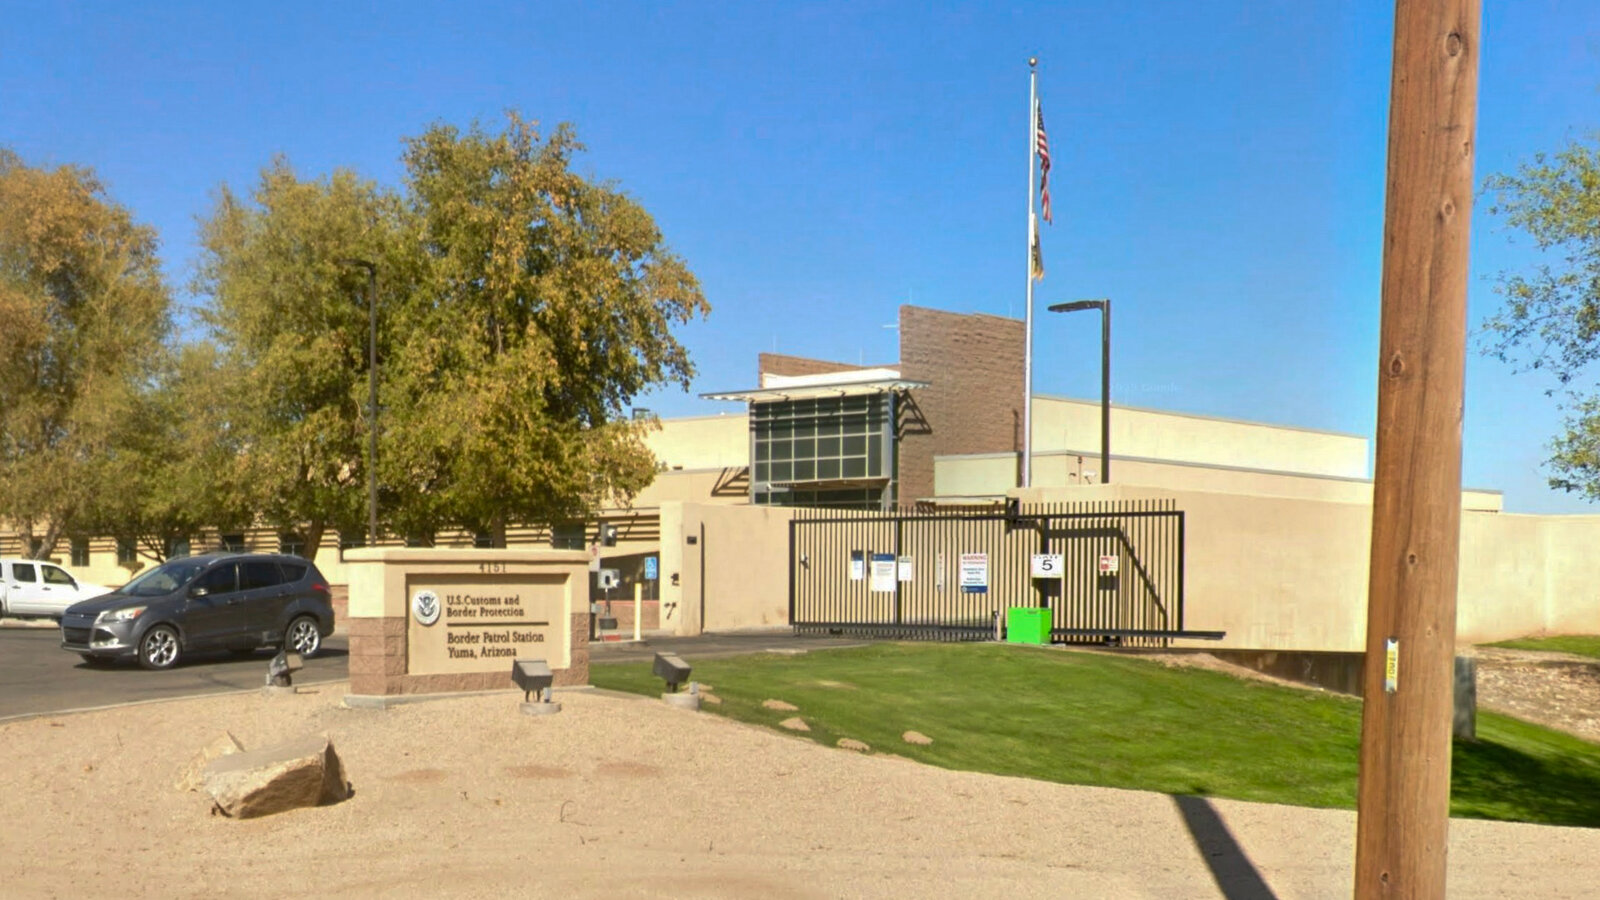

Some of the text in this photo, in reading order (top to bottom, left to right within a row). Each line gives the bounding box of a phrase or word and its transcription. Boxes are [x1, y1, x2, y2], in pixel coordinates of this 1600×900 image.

[479, 563, 506, 573] 4151
[1041, 560, 1053, 571] 5
[504, 595, 520, 605] and
[447, 607, 524, 617] Border Protection
[448, 631, 544, 644] Border Patrol Station
[448, 646, 516, 659] Yuma, Arizona
